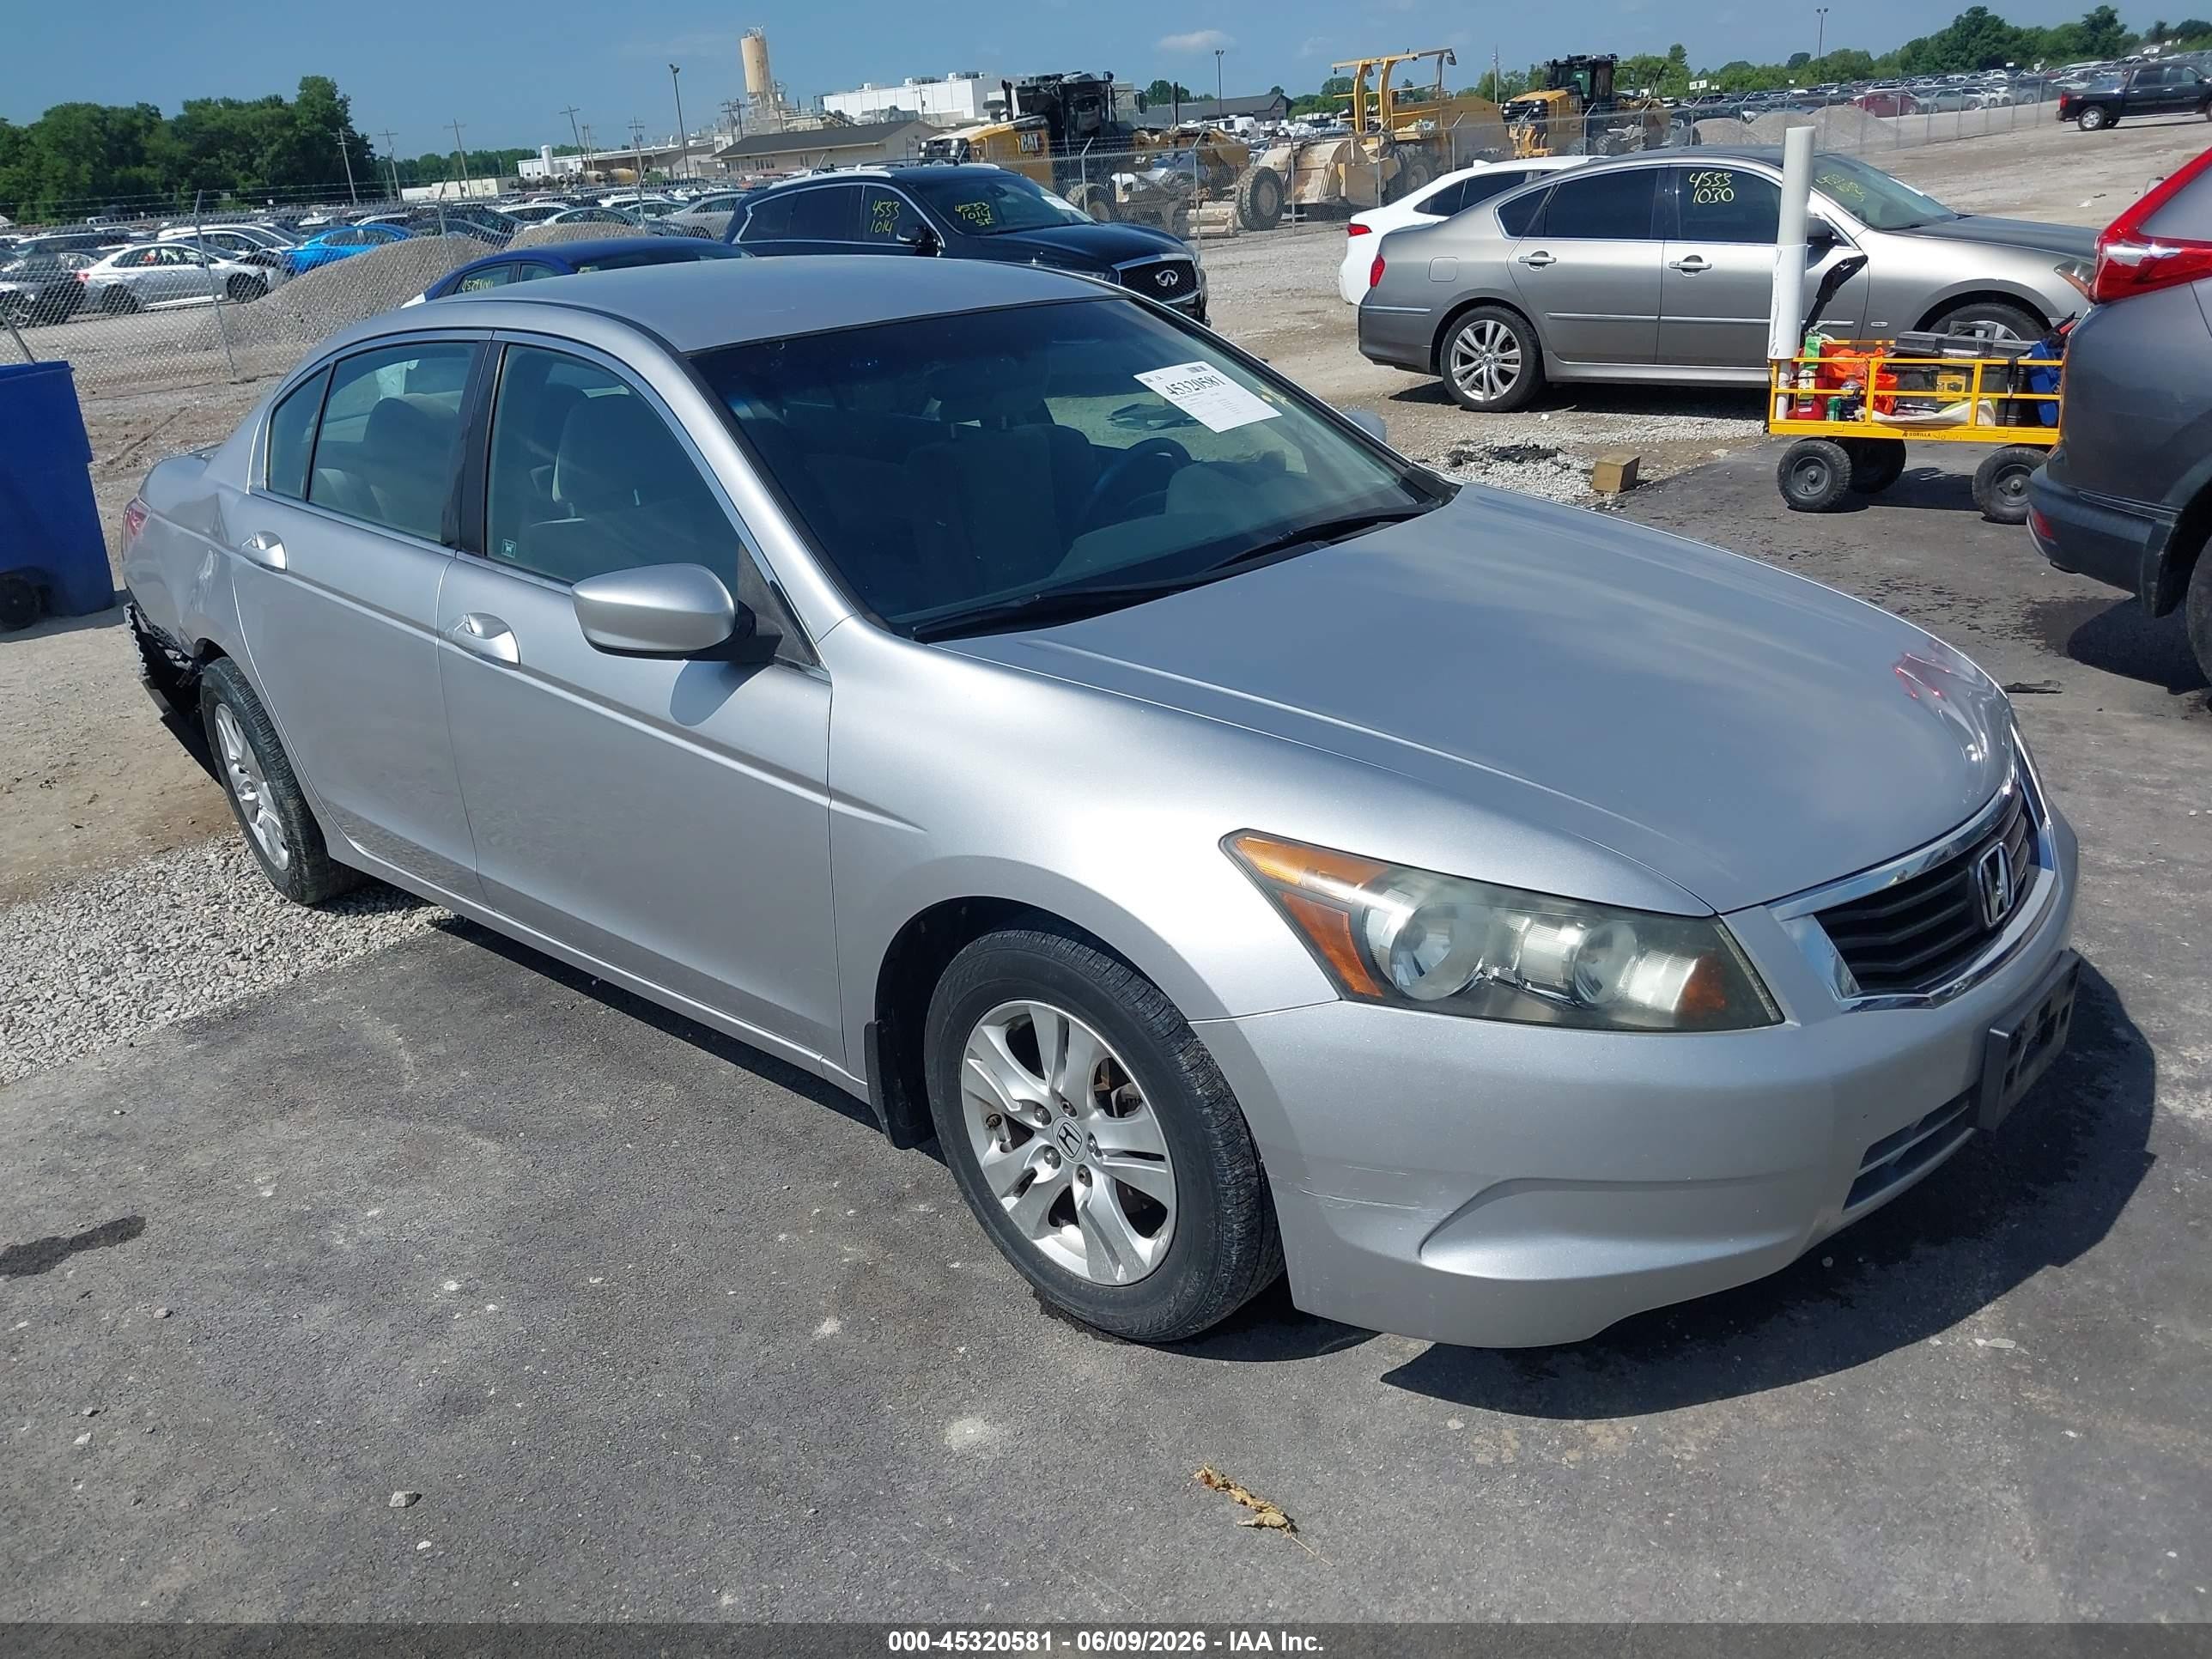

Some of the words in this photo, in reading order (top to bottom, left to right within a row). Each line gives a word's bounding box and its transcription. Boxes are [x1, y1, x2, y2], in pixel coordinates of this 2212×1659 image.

[1020, 132, 1039, 153] CAT
[1689, 172, 1733, 189] 4533
[1692, 187, 1735, 204] 1030
[872, 199, 901, 221] 4533
[870, 218, 894, 238] 1014
[1164, 374, 1226, 396] 45320581
